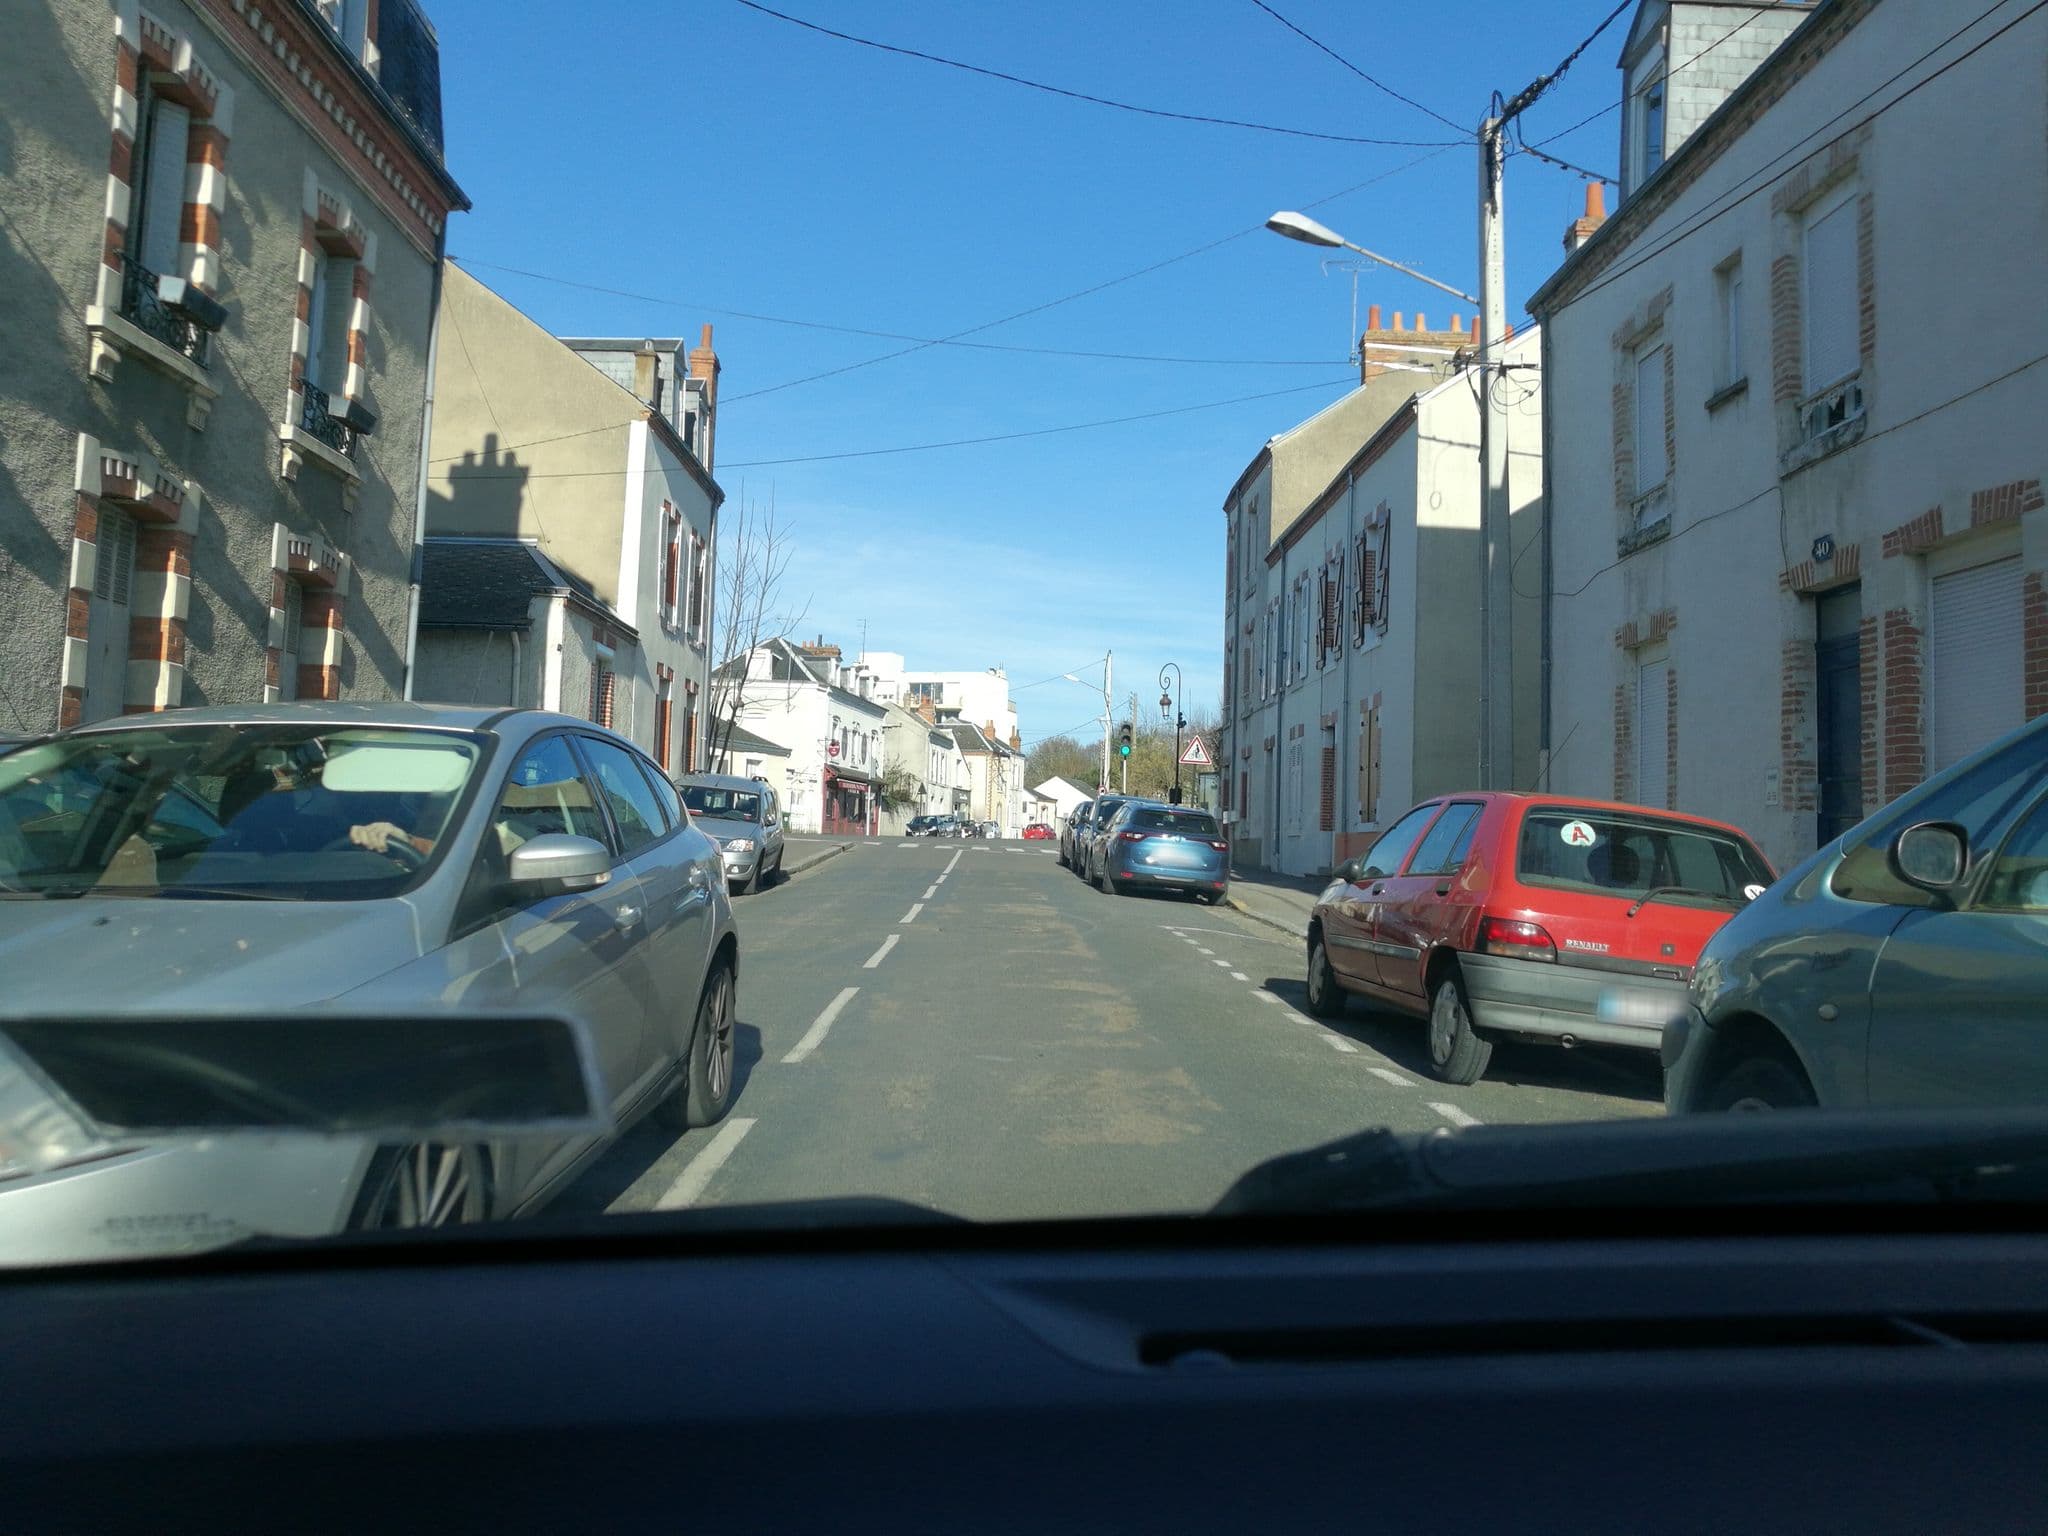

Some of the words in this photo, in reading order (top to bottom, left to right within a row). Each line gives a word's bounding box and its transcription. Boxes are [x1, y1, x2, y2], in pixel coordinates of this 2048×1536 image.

[1815, 541, 1829, 557] 40
[1571, 826, 1590, 842] A
[1565, 939, 1610, 952] RENAULT
